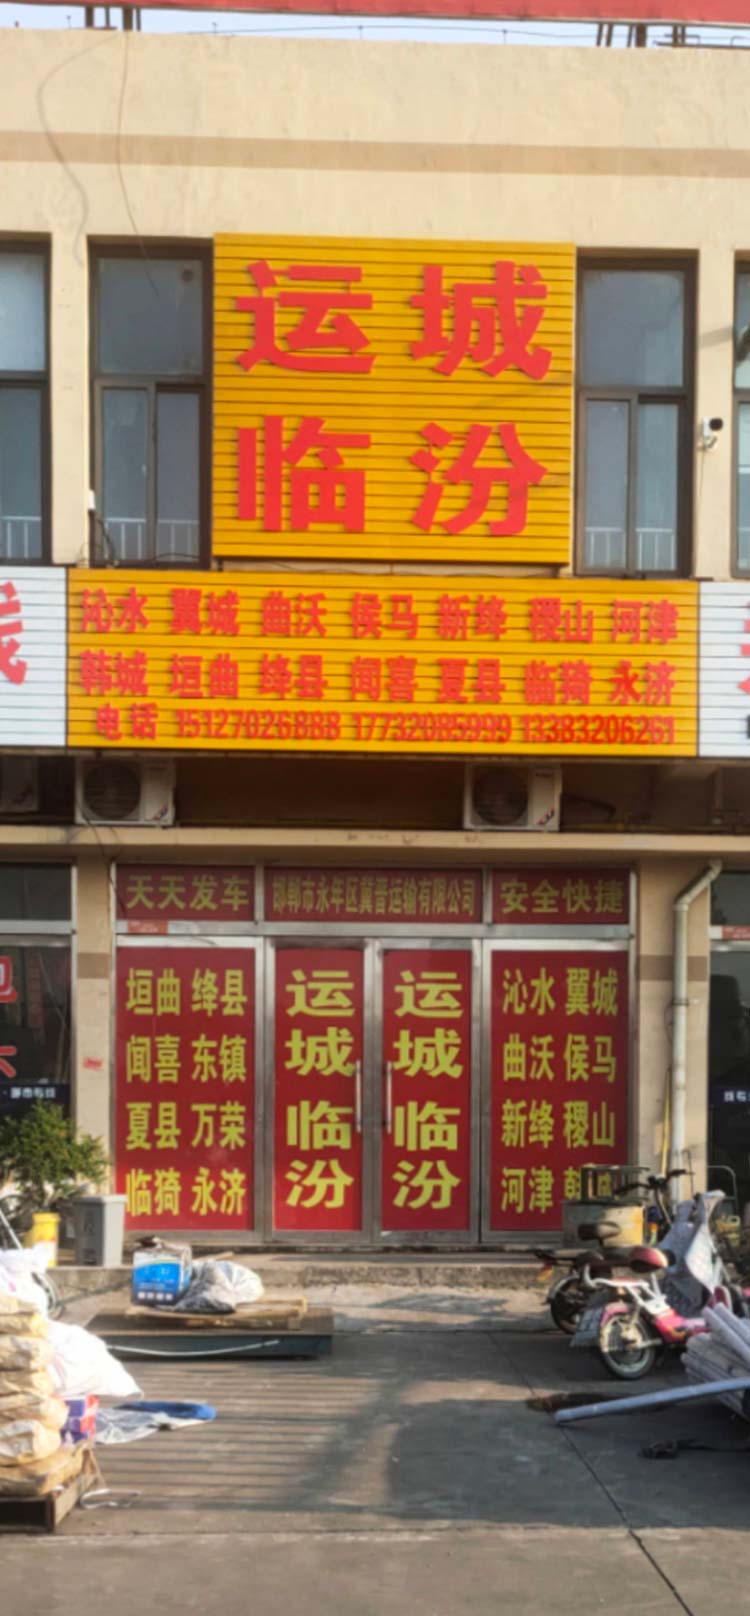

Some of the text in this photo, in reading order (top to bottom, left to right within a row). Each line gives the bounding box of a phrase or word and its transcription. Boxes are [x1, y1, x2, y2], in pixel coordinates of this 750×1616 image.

[236, 259, 553, 381] 运城
[235, 415, 548, 537] 临汾
[96, 703, 675, 745] 电话 15127026888 17732085999 13383206261
[126, 874, 249, 911] 天天发车
[501, 878, 624, 914] 安全快捷
